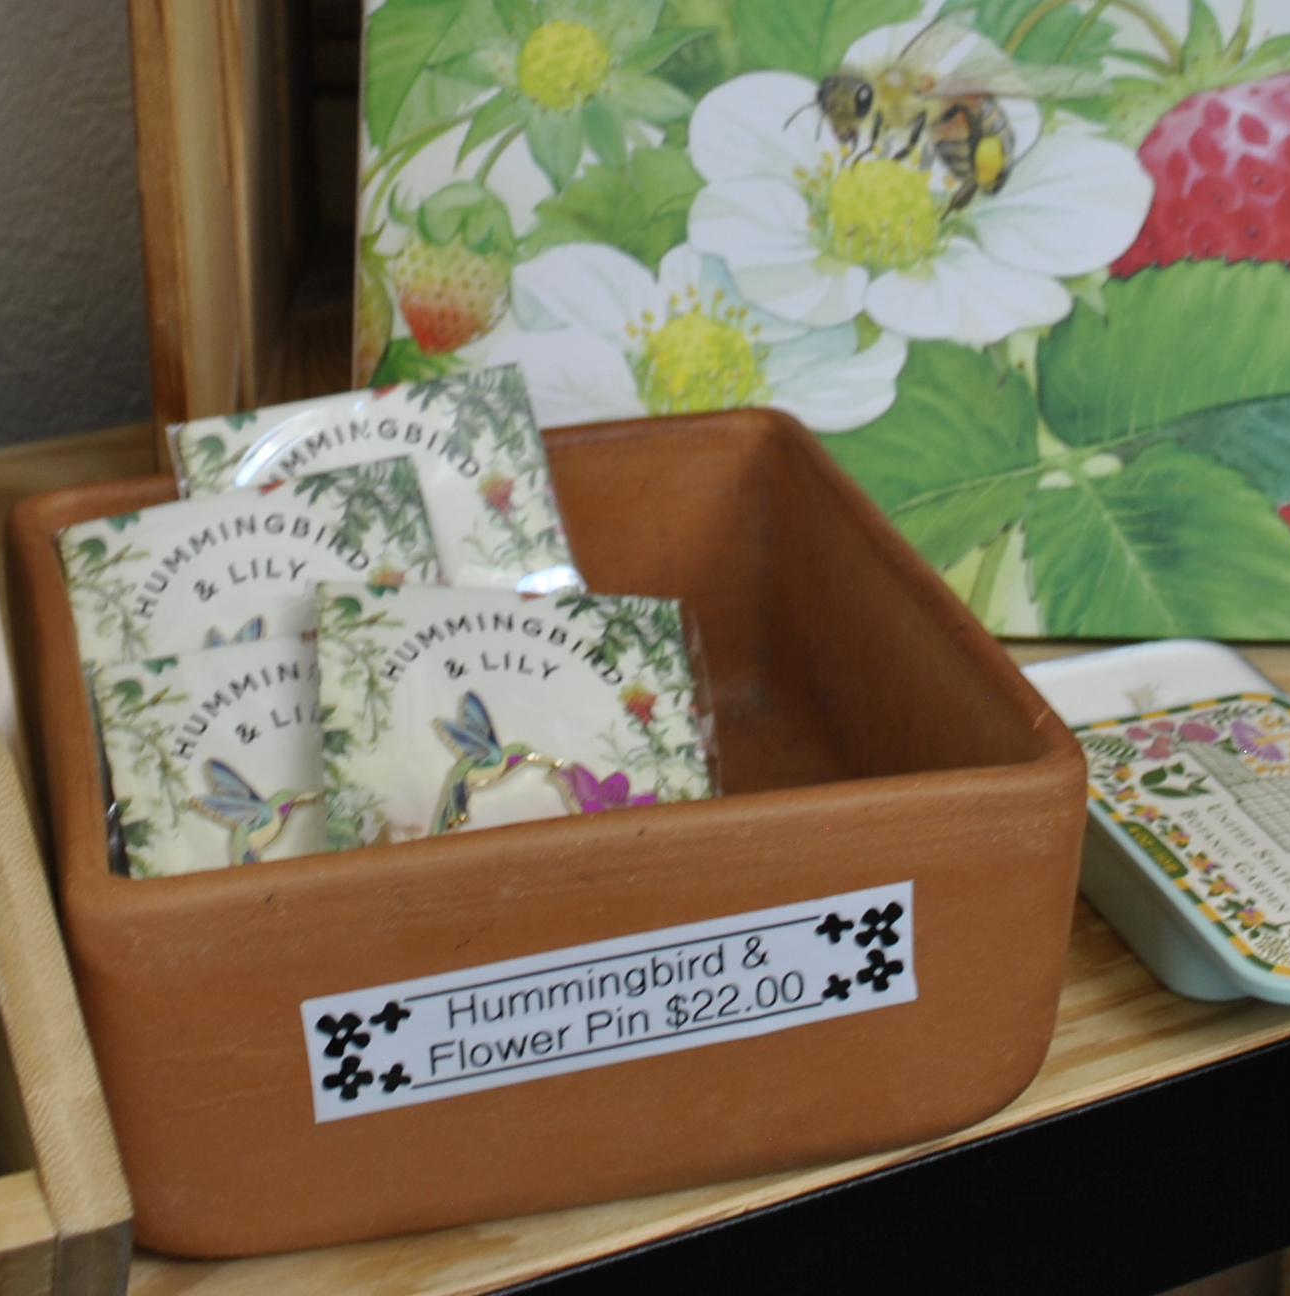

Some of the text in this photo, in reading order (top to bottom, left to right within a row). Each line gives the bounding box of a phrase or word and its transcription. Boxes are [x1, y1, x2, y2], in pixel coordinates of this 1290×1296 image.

[133, 513, 371, 621] HUMMINGBIRD
[194, 556, 308, 603] & LILY
[378, 611, 625, 688] HUMMINGBIRD
[443, 650, 560, 681] & LILY
[234, 720, 262, 745] &
[447, 934, 770, 1030] Hummingbird &
[428, 969, 805, 1078] Flower Pin $22.00
